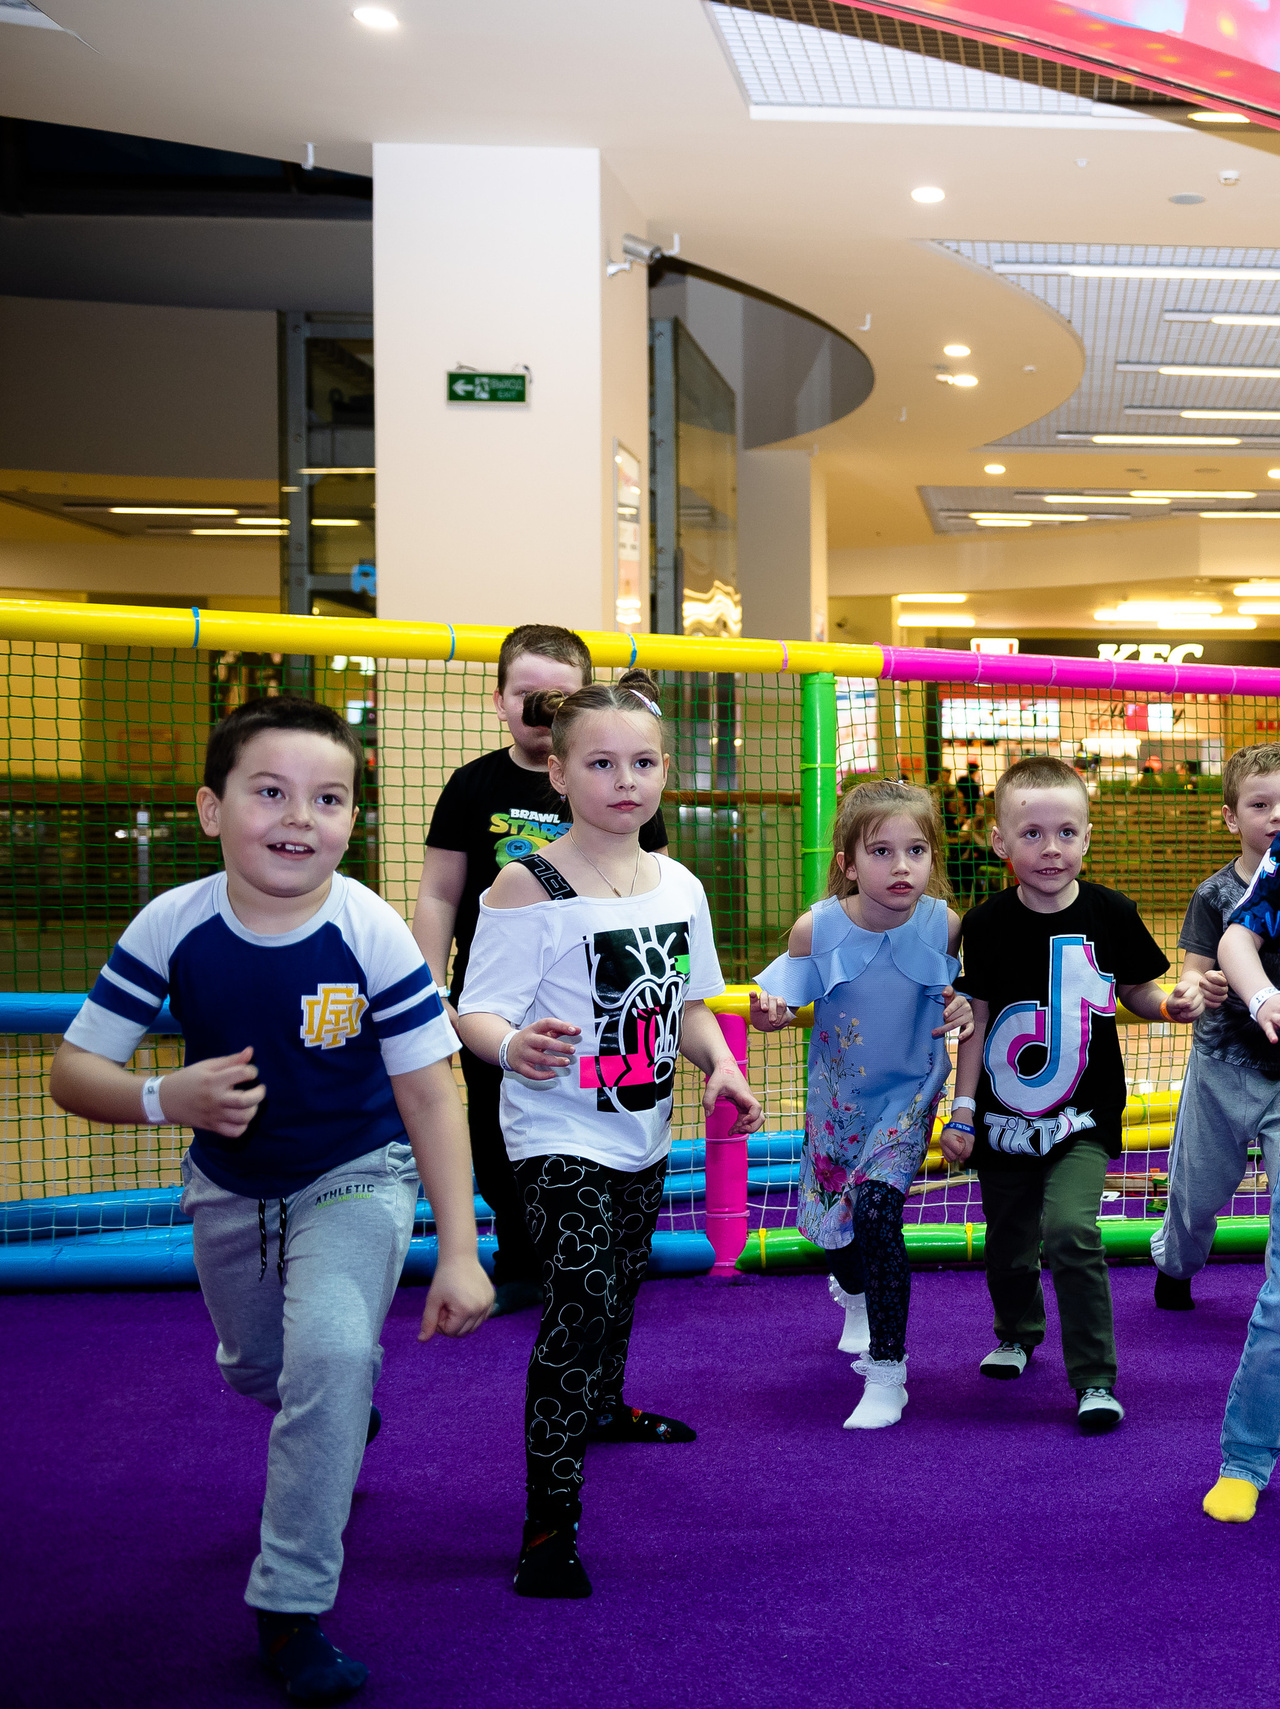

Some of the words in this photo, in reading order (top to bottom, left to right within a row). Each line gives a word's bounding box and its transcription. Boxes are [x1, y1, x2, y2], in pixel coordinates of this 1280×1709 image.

[488, 813, 574, 841] STARS
[509, 808, 561, 824] BRAWL
[314, 1184, 375, 1206] ATHLETIC
